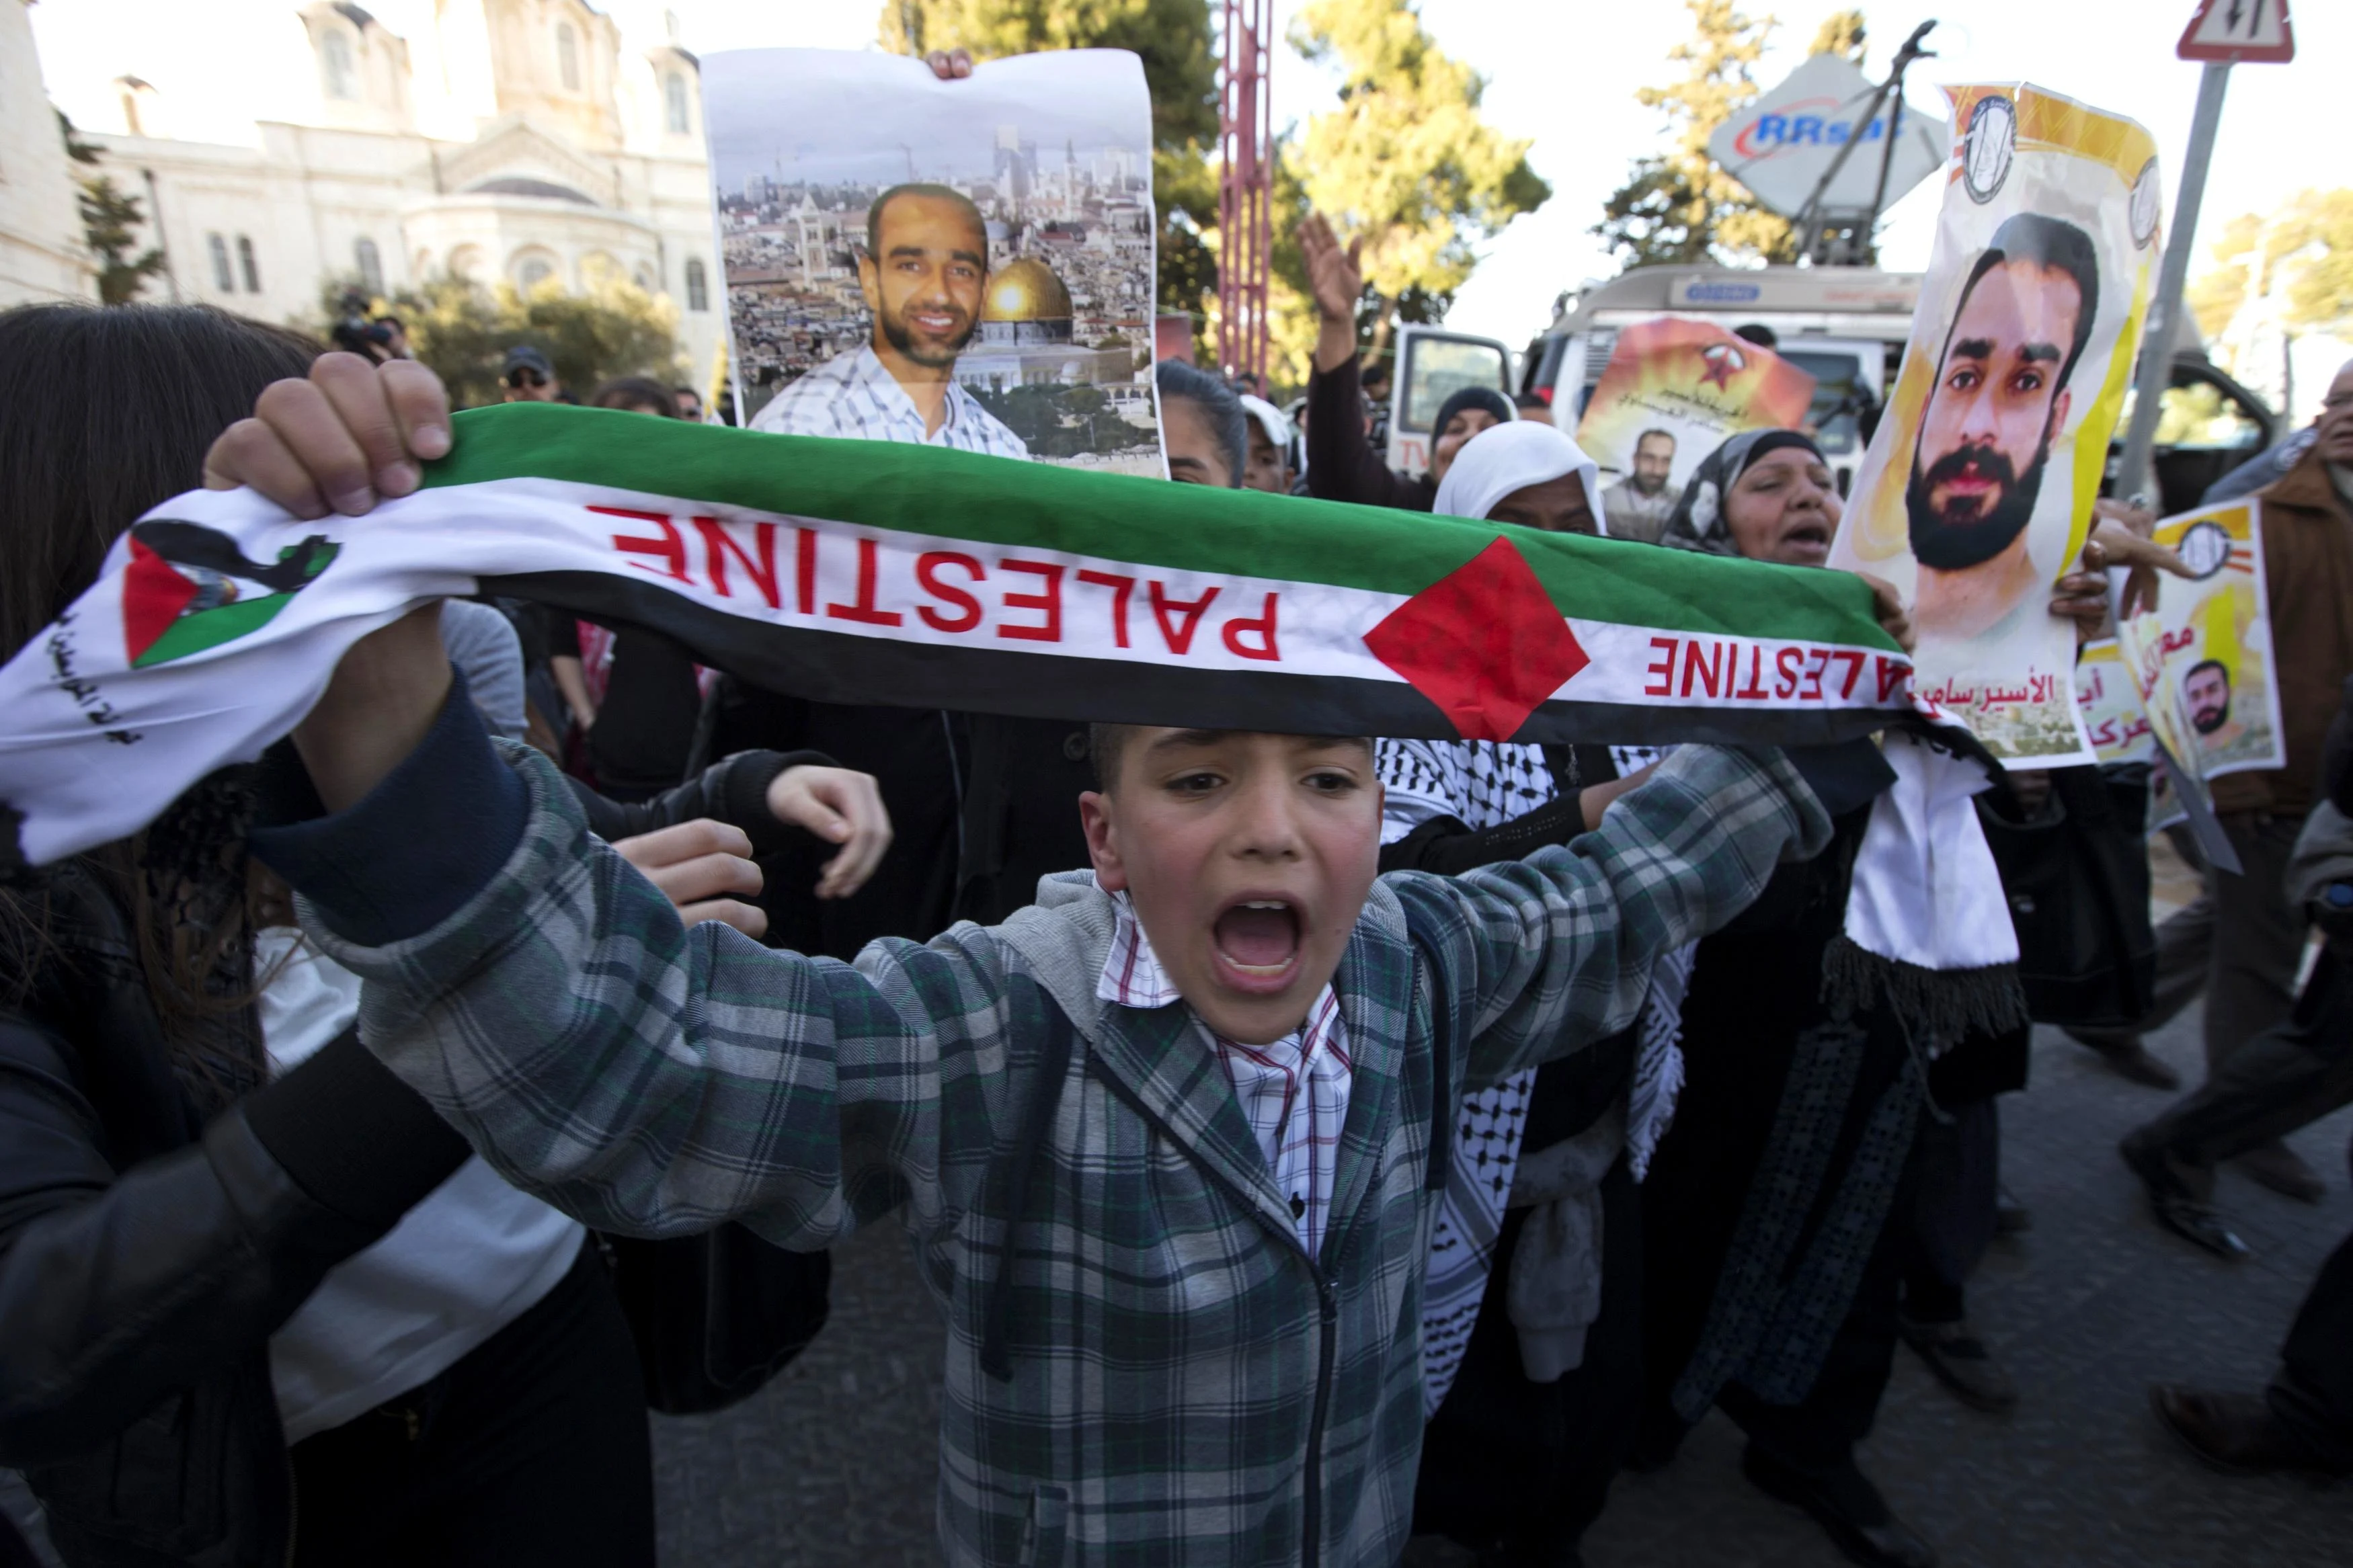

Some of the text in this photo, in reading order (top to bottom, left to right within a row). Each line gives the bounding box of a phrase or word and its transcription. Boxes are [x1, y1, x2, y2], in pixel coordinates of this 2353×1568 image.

[587, 505, 1282, 662] PALESTINE
[1644, 636, 1916, 703] ALESTINE
[1979, 665, 2055, 711] الأسير
